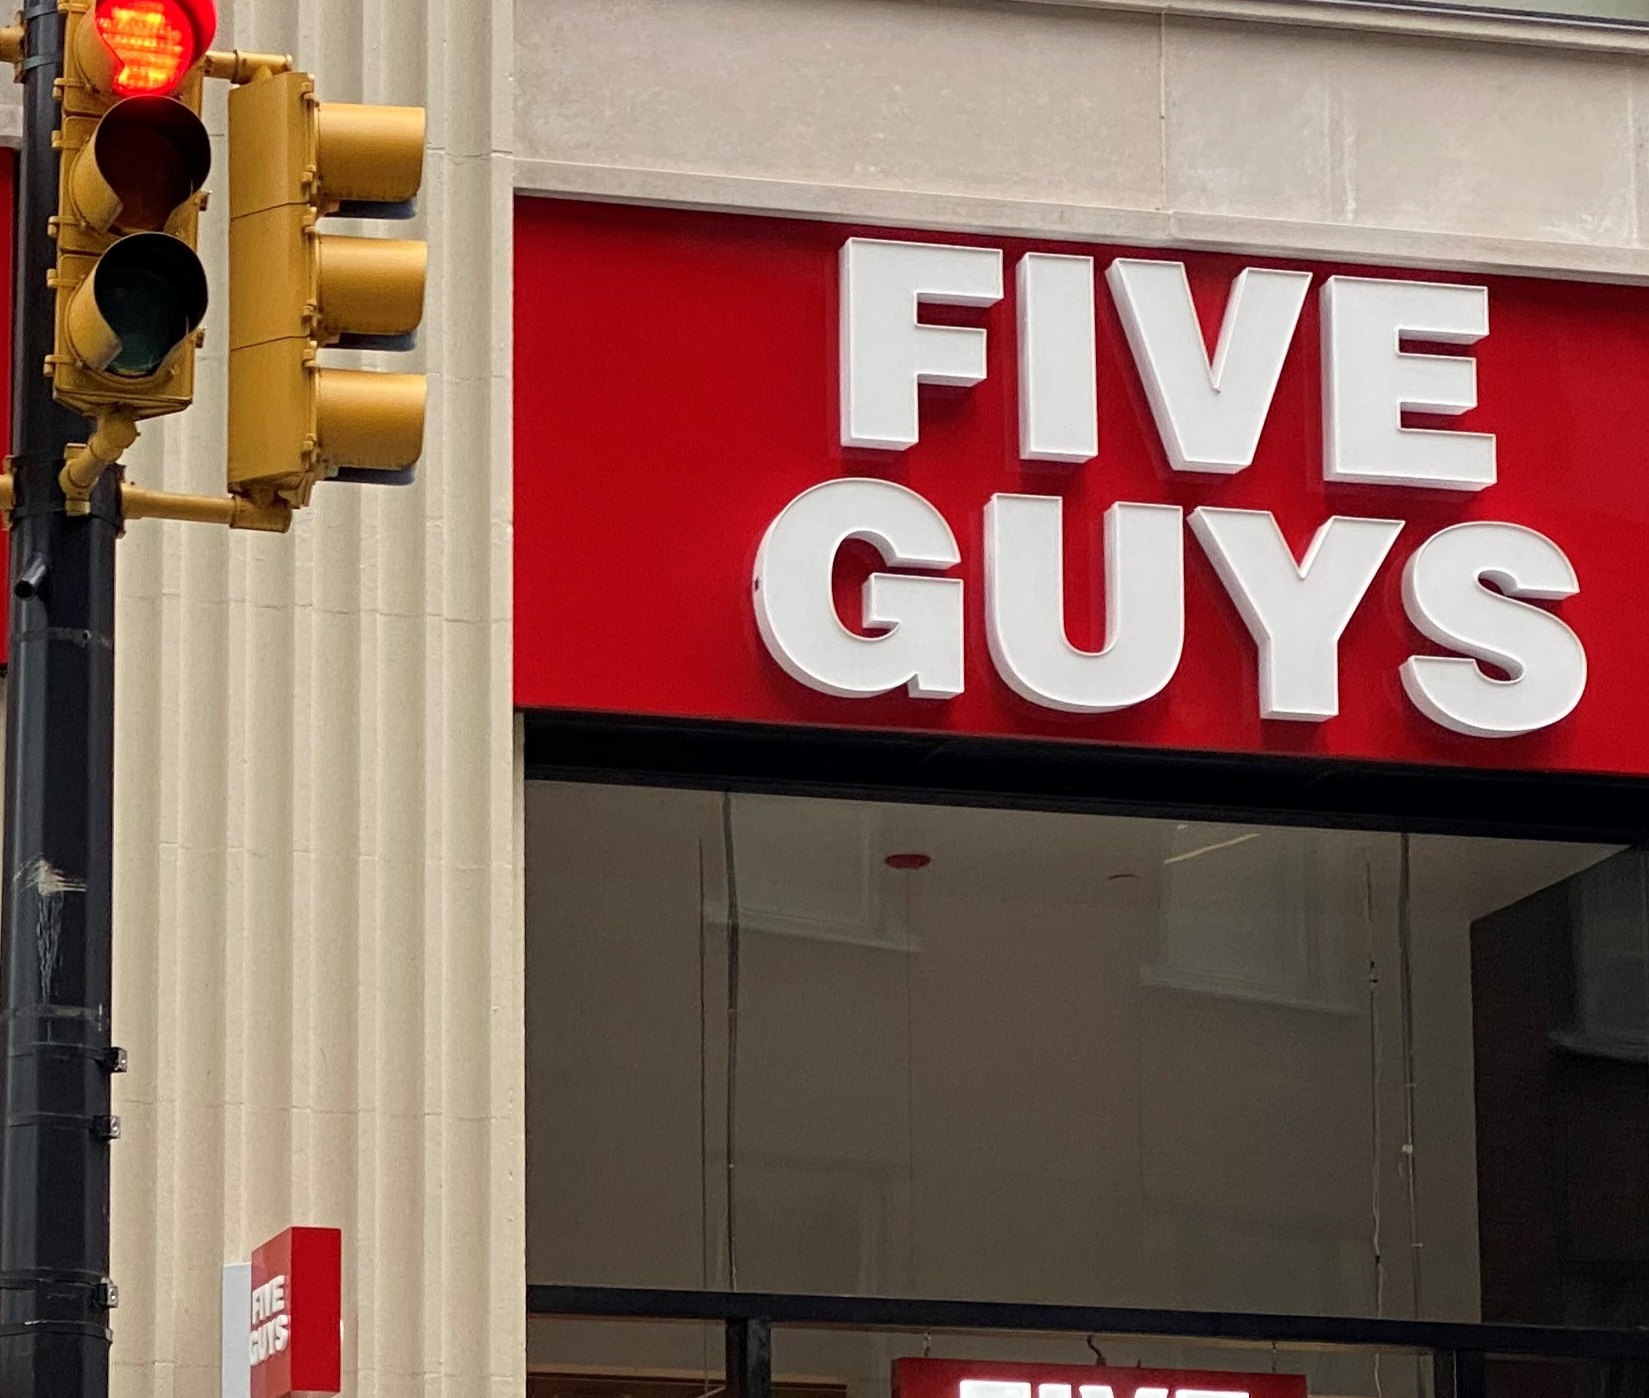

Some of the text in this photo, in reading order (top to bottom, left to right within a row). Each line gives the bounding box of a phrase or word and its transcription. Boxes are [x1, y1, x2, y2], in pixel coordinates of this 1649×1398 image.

[840, 236, 1497, 490] FIVE
[752, 477, 1588, 738] GUYS
[250, 1315, 289, 1366] GUYS
[252, 1275, 285, 1324] FIVE
